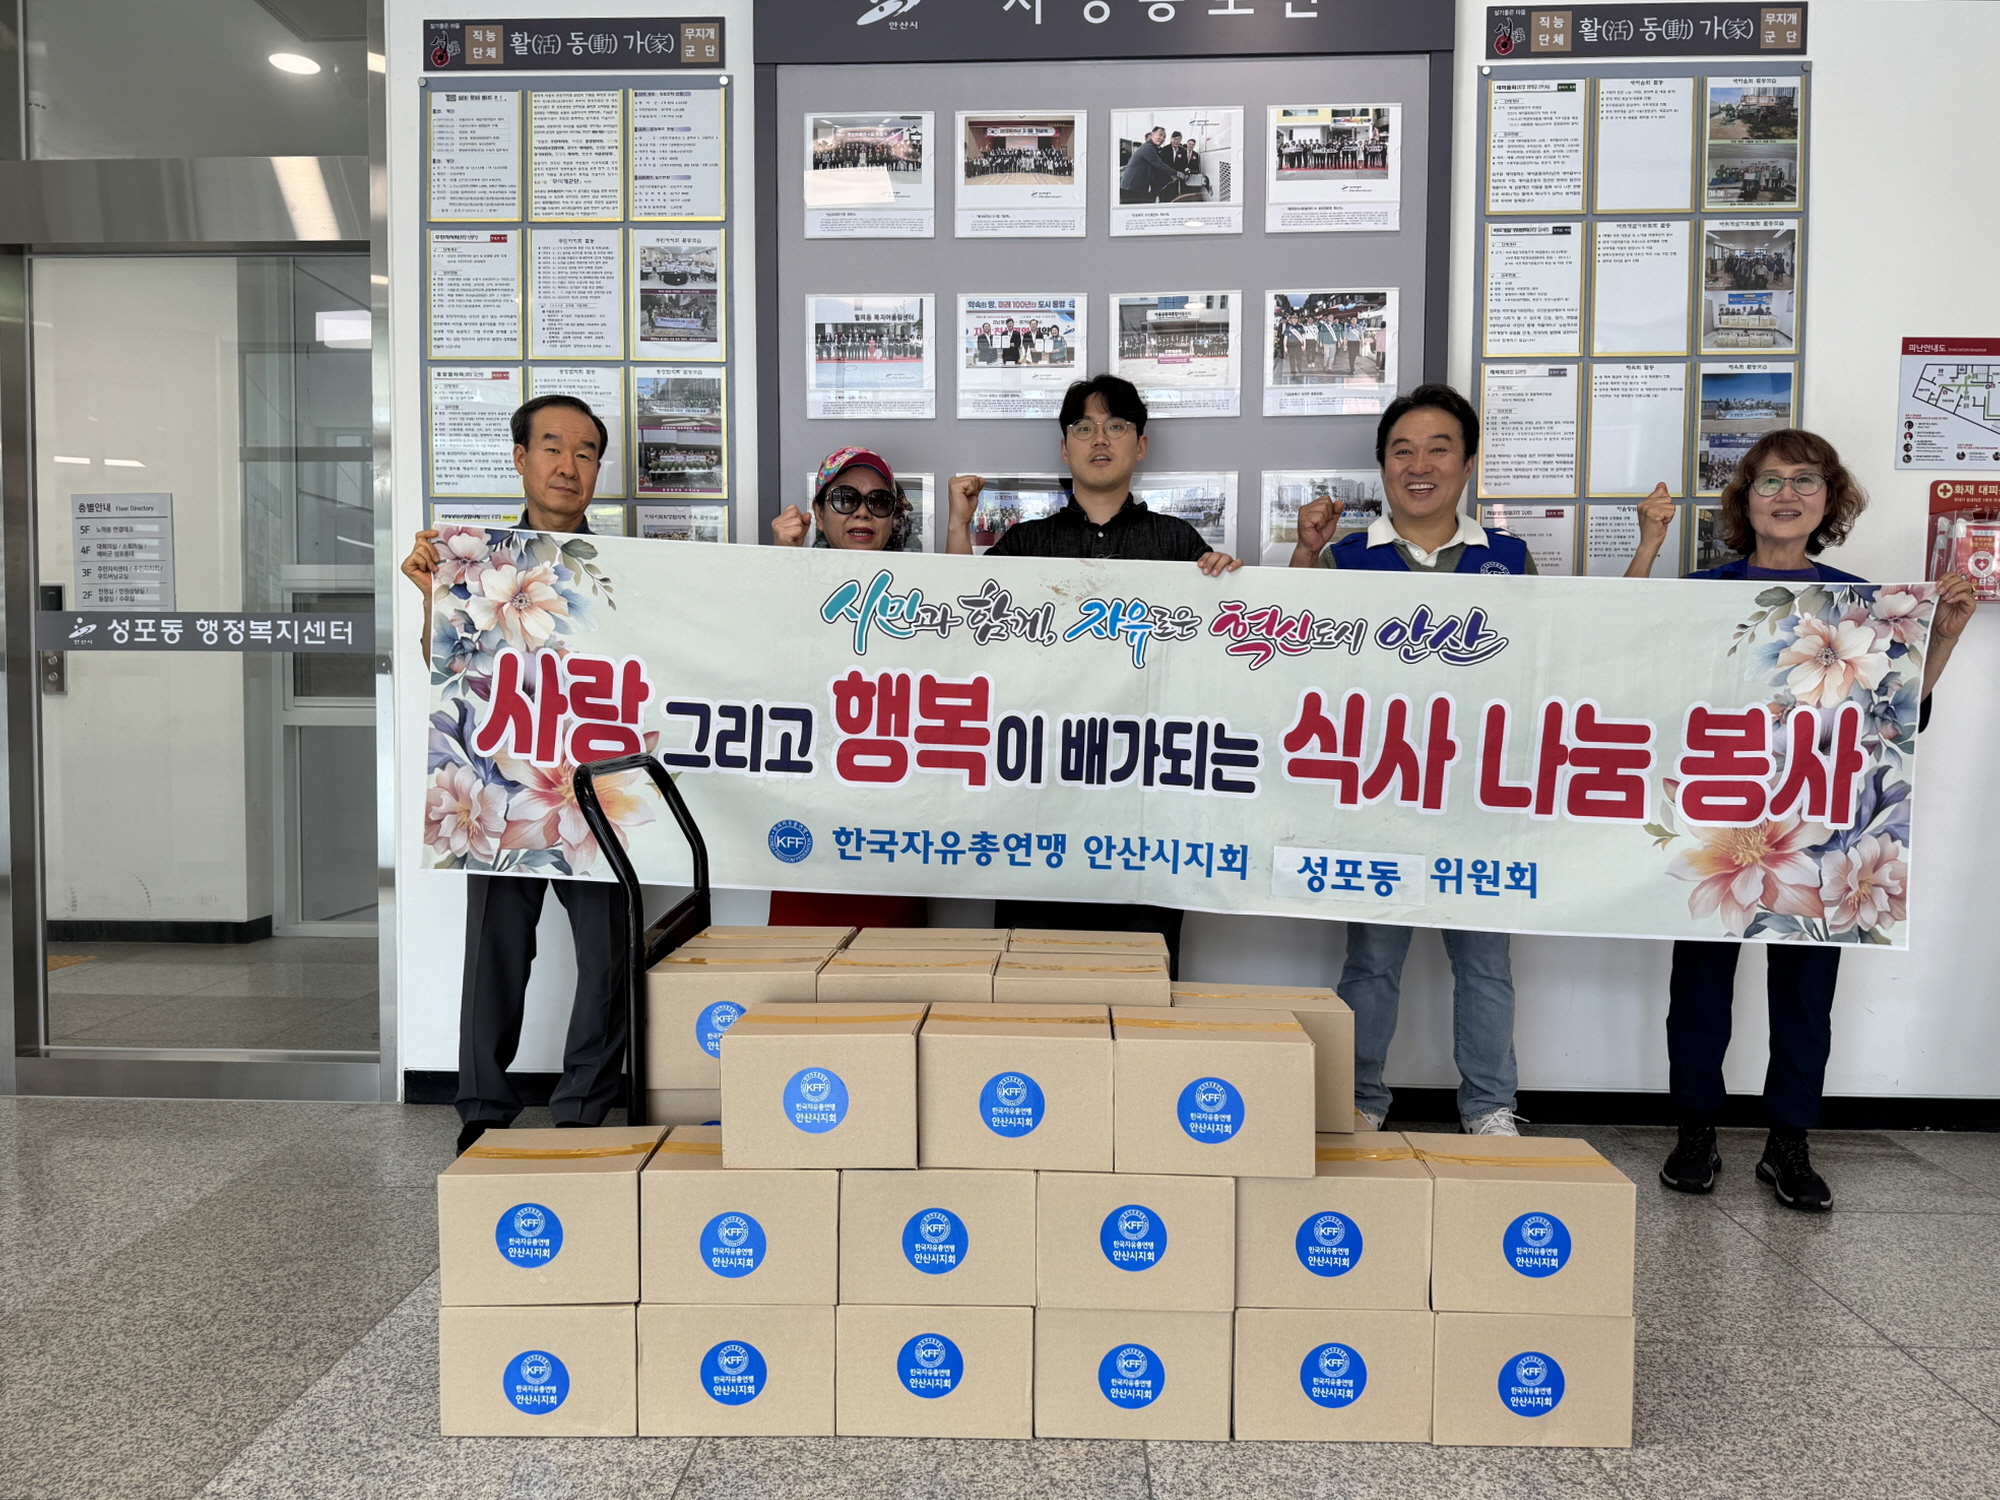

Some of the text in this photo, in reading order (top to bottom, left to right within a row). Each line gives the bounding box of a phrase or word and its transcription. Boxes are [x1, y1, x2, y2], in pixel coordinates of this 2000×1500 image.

[1764, 12, 1797, 26] 무지개
[888, 21, 918, 30] 안산시
[1578, 16, 1754, 42] 활(活) 동(動) 가(家)
[684, 28, 716, 41] 무지개
[510, 31, 674, 55] 활(活) 동(動) 가(家)
[1038, 300, 1051, 308] 도시
[1908, 344, 1946, 353] 피난안내도
[1954, 484, 2000, 495] 화재 대피
[79, 503, 111, 513] 층별안내
[80, 526, 90, 534] 5F
[81, 546, 91, 555] 4F
[82, 569, 91, 577] 3F
[83, 591, 92, 600] 2F
[820, 569, 962, 655] 시민과
[1063, 598, 1202, 668] 자유로운
[1208, 600, 1368, 670] 혁신도시
[1375, 604, 1509, 666] 안산
[108, 618, 352, 646] 성포동 행정복지센터
[475, 651, 1864, 824] 사랑 그리고 행복이 배가되는 식사 나눔 봉사
[776, 836, 806, 848] KFF
[832, 826, 1537, 899] 한국자유총연맹 안산시지회 성포동 위원회
[806, 1083, 825, 1092] KFF
[1003, 1087, 1021, 1096] KFF
[1202, 1093, 1220, 1102] KFF
[796, 1103, 836, 1112] 한국자유총연맹
[992, 1107, 1032, 1115] 한국자유총연맹
[796, 1113, 837, 1124] 안산시지회
[1190, 1112, 1231, 1122] 한국자유총연맹
[992, 1117, 1033, 1128] 안산시지회
[1190, 1123, 1232, 1134] 안산시지회
[520, 1219, 539, 1227] KFF
[1124, 1221, 1143, 1229] KFF
[724, 1228, 743, 1236] KFF
[926, 1224, 945, 1233] KFF
[1320, 1227, 1339, 1236] KFF
[1527, 1228, 1546, 1236] KFF
[508, 1238, 550, 1246] 한국자유총연맹
[1113, 1240, 1154, 1249] 한국자유총연맹
[712, 1247, 753, 1256] 한국자유총연맹
[915, 1243, 955, 1252] 한국자유총연맹
[1308, 1246, 1350, 1256] 한국자유총연맹
[1516, 1247, 1558, 1256] 한국자유총연맹
[508, 1247, 550, 1258] 안산시지회
[1112, 1250, 1155, 1262] 안산시지회
[712, 1257, 754, 1268] 안산시지회
[914, 1254, 956, 1264] 안산시지회
[1308, 1256, 1350, 1268] 안산시지회
[1516, 1257, 1558, 1268] 안산시지회
[921, 1349, 939, 1357] KFF
[724, 1356, 743, 1364] KFF
[1123, 1360, 1141, 1368] KFF
[1325, 1359, 1344, 1367] KFF
[527, 1366, 546, 1374] KFF
[910, 1369, 951, 1377] 한국자유총연맹
[1522, 1367, 1541, 1376] KFF
[713, 1376, 754, 1384] 한국자유총연맹
[909, 1378, 951, 1389] 안산시지회
[1111, 1378, 1151, 1387] 한국자유총연맹
[1313, 1378, 1354, 1386] 한국자유총연맹
[516, 1385, 557, 1393] 한국자유총연맹
[713, 1385, 755, 1396] 안산시지회
[1110, 1388, 1152, 1399] 안산시지회
[1312, 1387, 1354, 1399] 안산시지회
[1511, 1387, 1551, 1395] 한국자유총연맹
[516, 1394, 557, 1405] 안산시지회
[1510, 1396, 1552, 1407] 안산시지회
